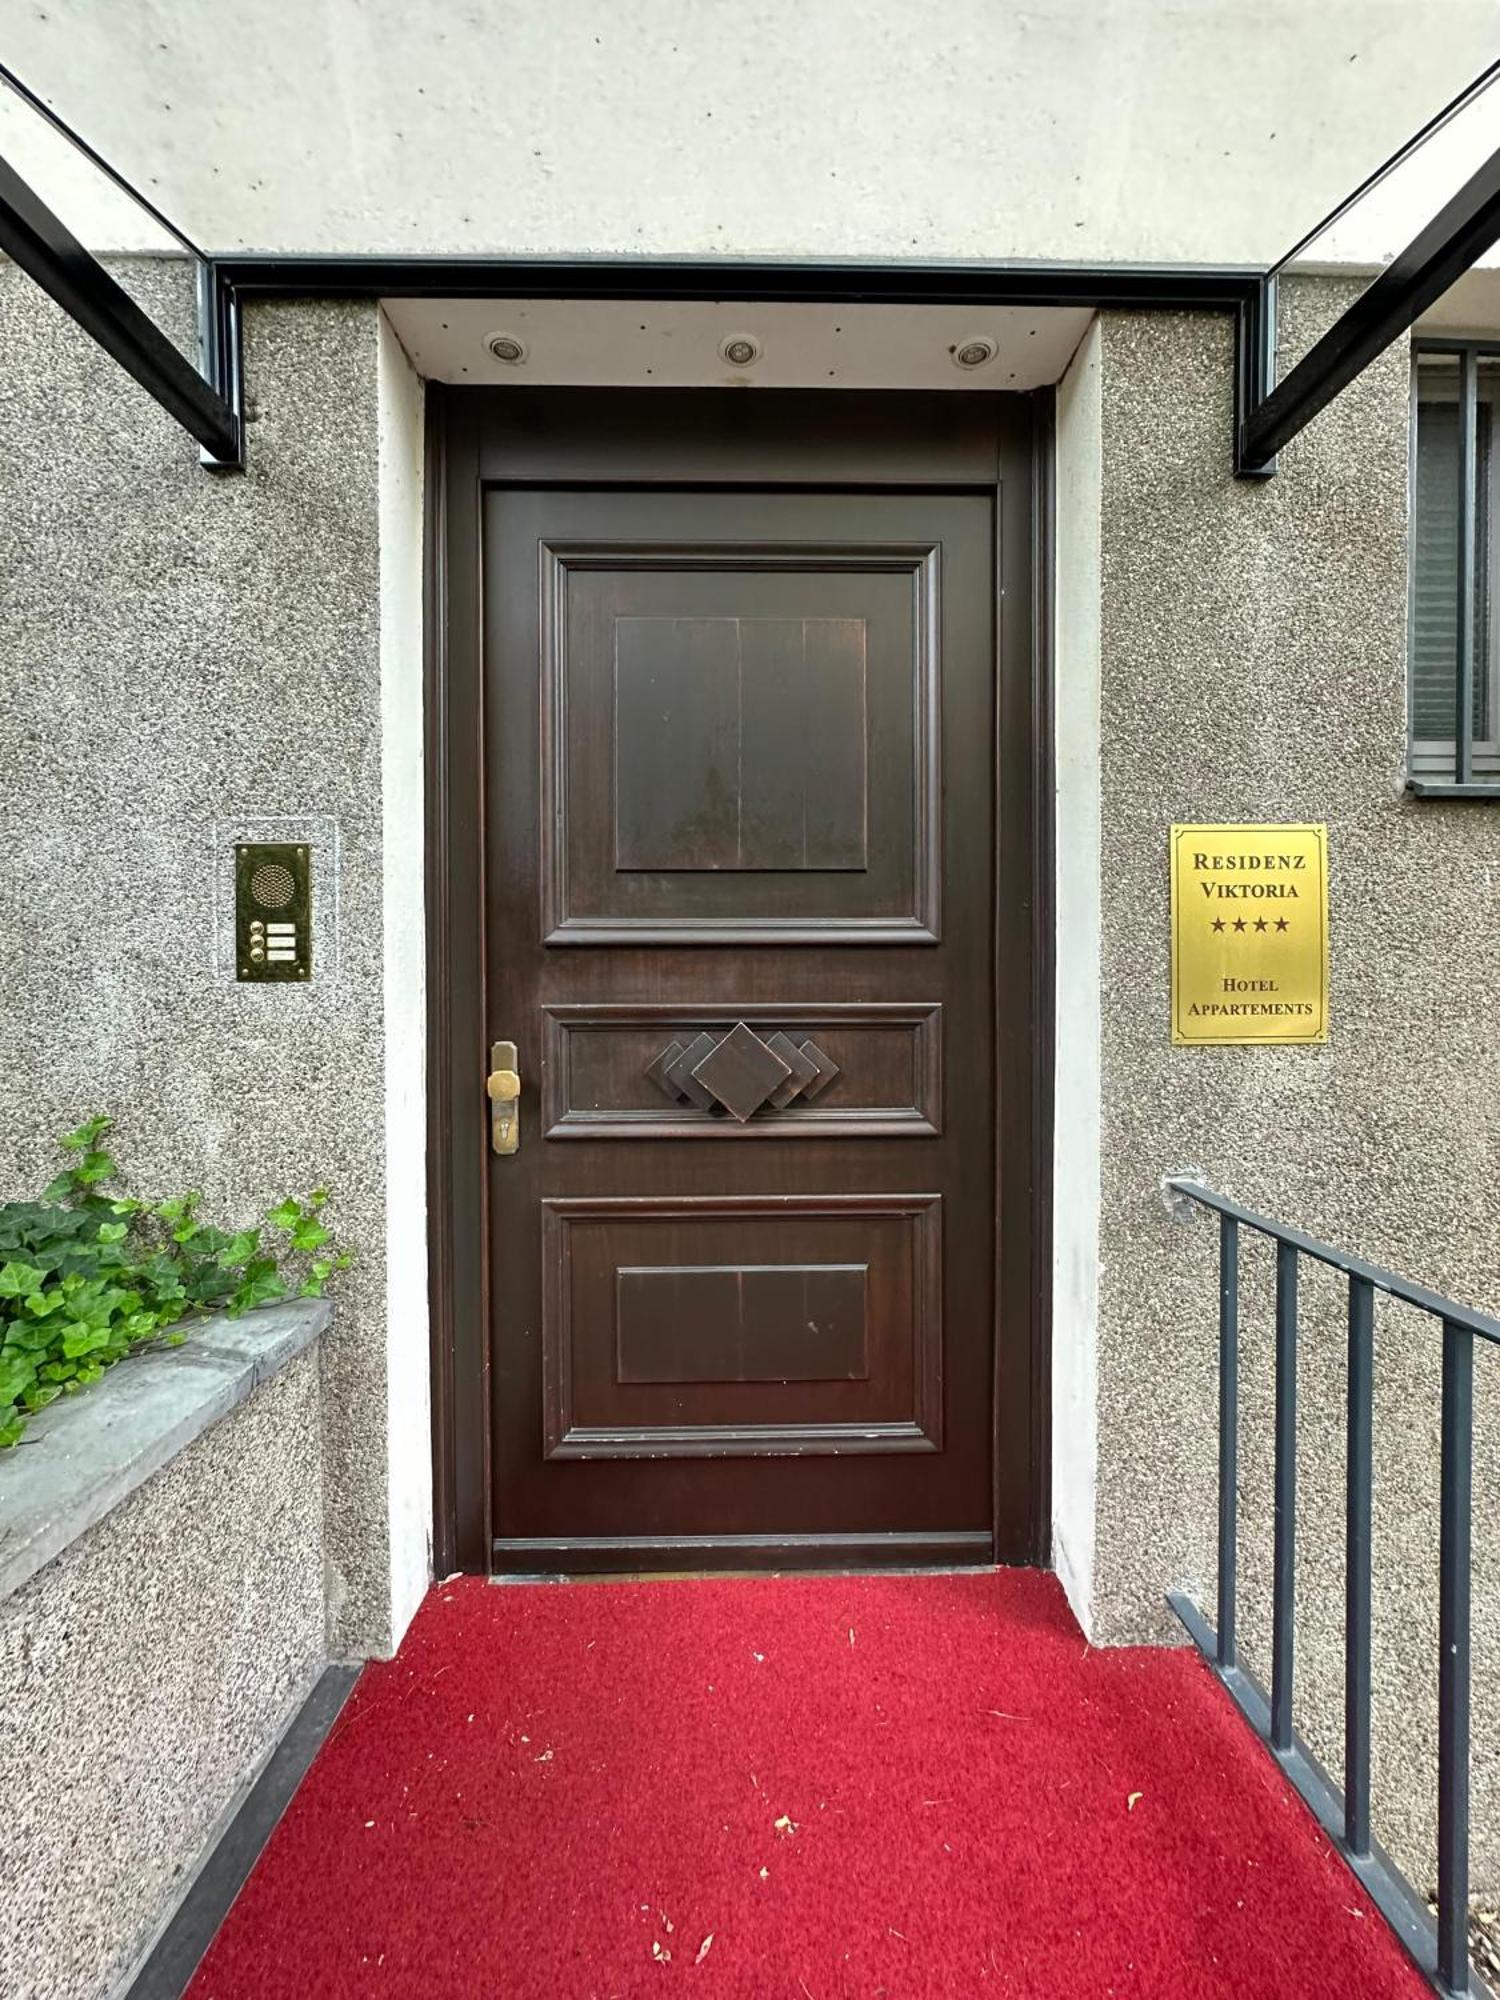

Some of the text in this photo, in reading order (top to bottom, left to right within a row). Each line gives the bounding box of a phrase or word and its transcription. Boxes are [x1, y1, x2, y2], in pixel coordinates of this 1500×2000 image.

[1193, 853, 1306, 870] RESIDENZ
[1200, 882, 1299, 898] VIKTORIA
[1222, 977, 1279, 992] HOTEL
[1187, 1002, 1313, 1016] APPARTEMENTS
